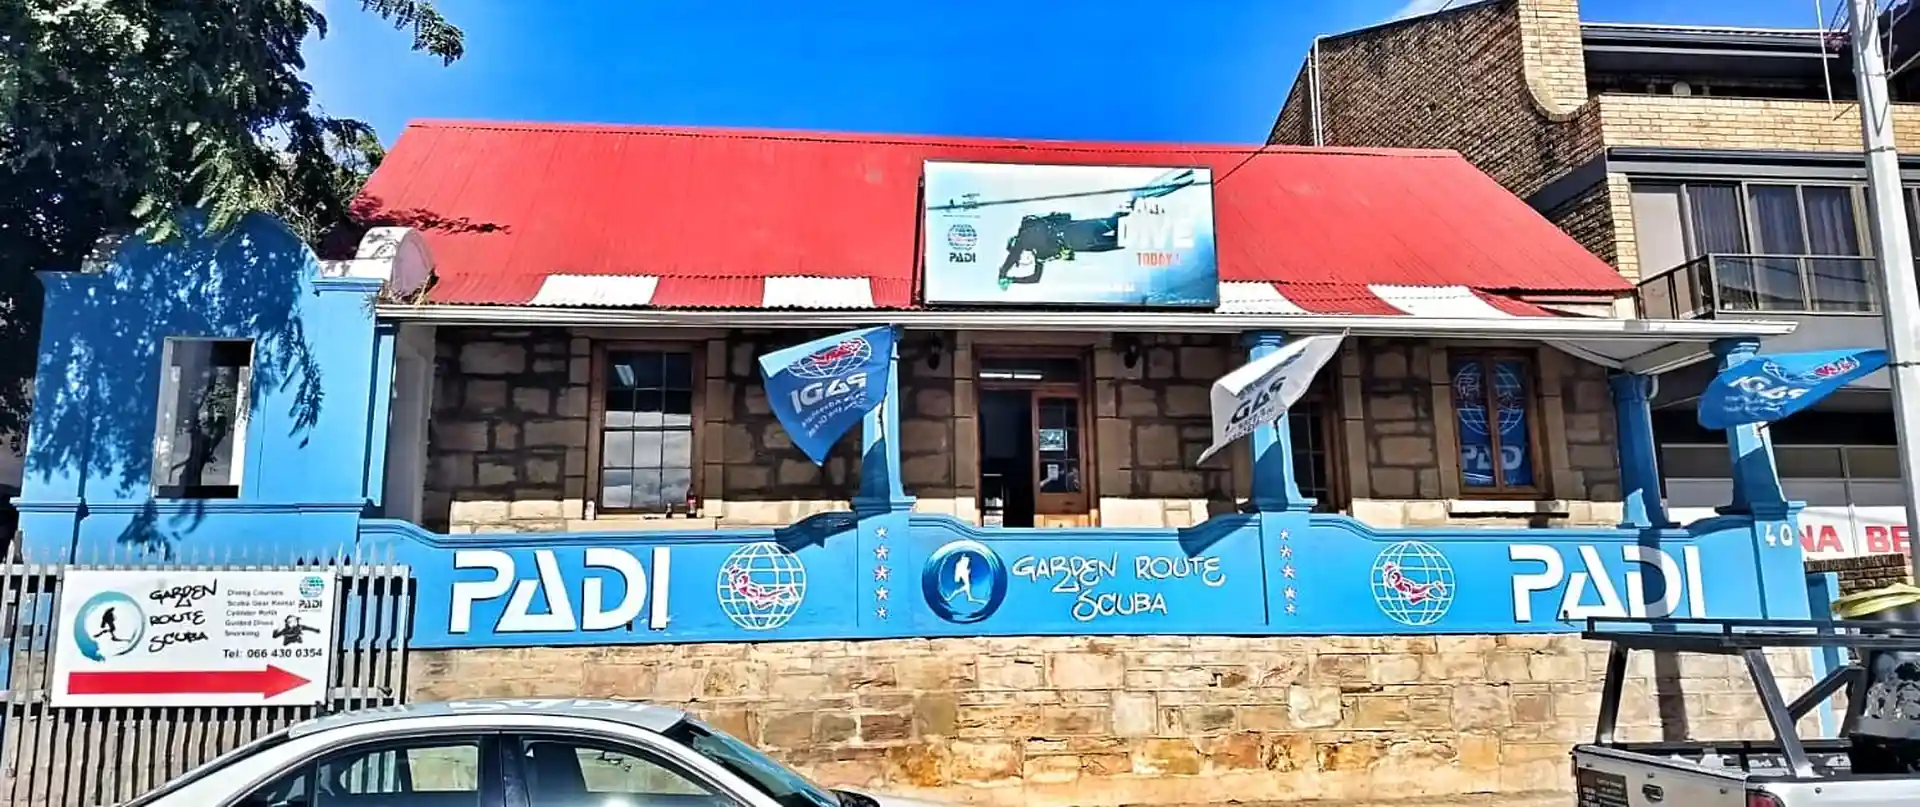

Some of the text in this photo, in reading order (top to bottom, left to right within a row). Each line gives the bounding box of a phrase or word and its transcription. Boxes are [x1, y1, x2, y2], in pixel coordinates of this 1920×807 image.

[949, 252, 976, 263] PADI
[1764, 524, 1793, 547] 40
[1012, 552, 1226, 593] GARDEN ROUTE
[1508, 544, 1706, 623] PADI
[149, 579, 217, 608] GARDEN
[448, 547, 671, 634] PADI
[298, 599, 322, 609] PADI
[1072, 590, 1168, 625] SCUBA
[150, 610, 206, 626] ROUTE
[148, 631, 209, 652] SCUBA
[246, 648, 268, 658] 066
[271, 648, 292, 658] 430
[295, 647, 323, 658] 0354
